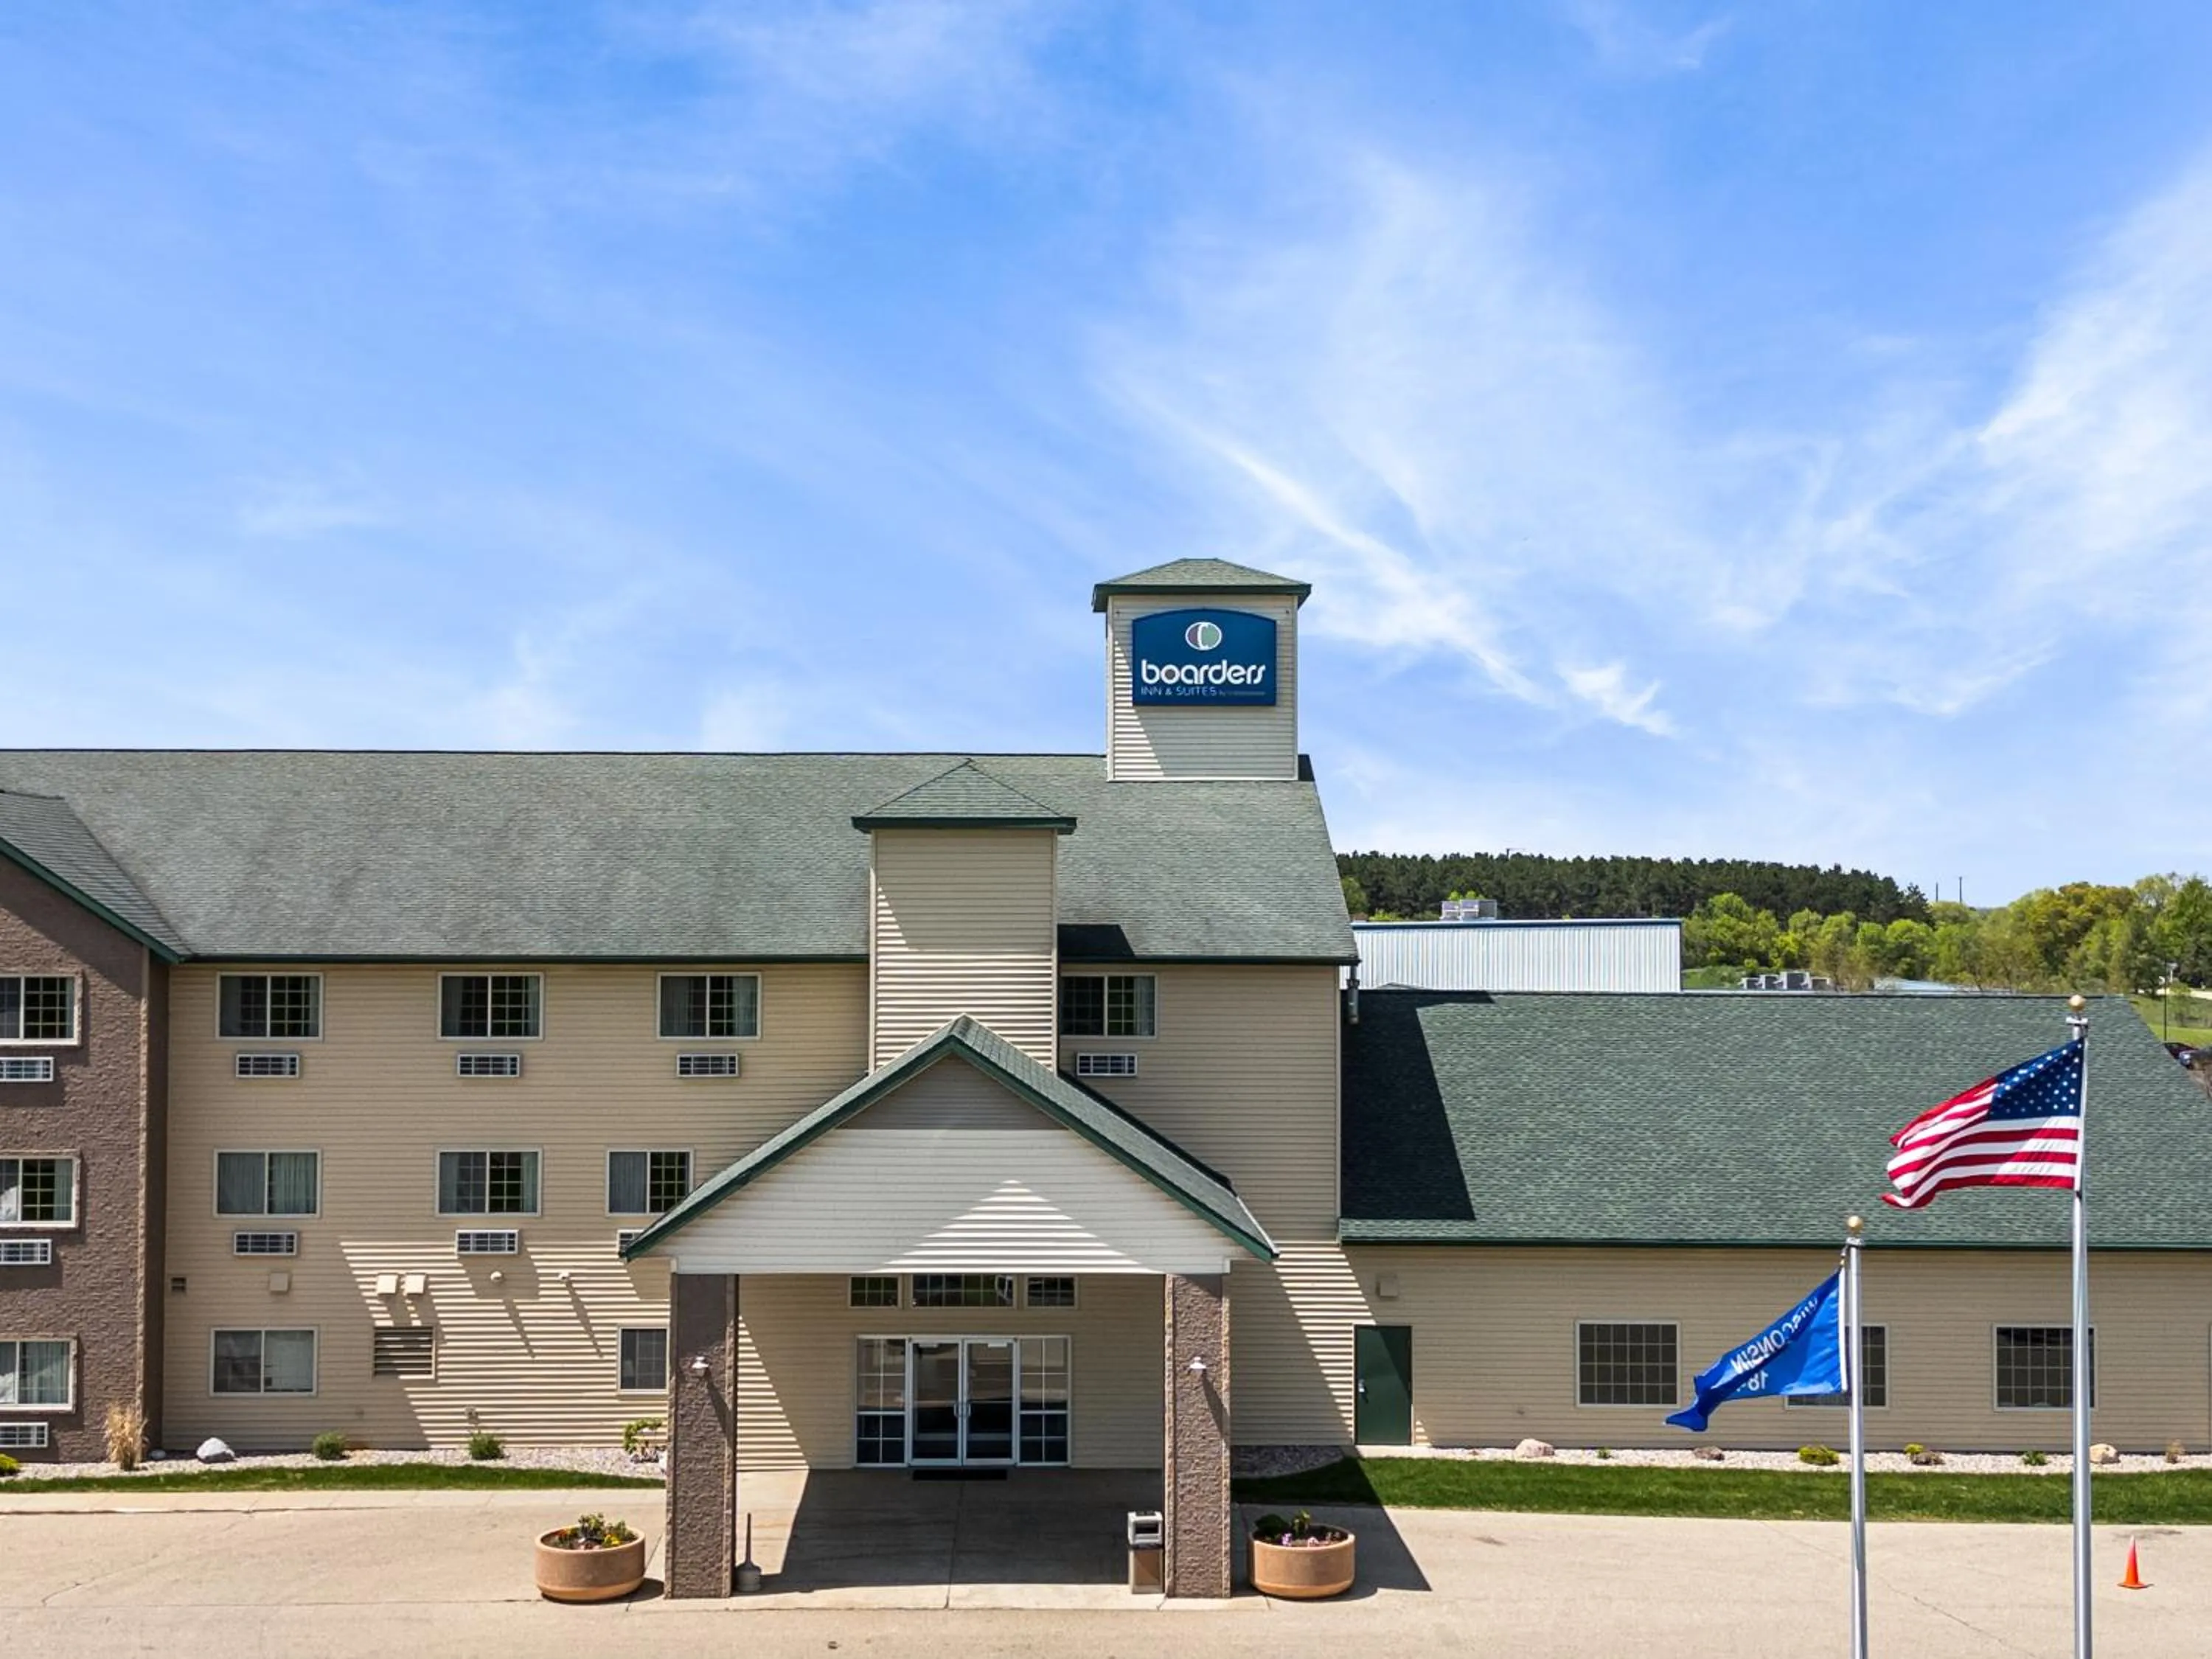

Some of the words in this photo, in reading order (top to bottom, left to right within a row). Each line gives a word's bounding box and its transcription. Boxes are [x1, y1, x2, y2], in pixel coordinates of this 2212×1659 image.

[1141, 658, 1266, 685] boarders
[1141, 686, 1162, 696] INN
[1164, 687, 1173, 696] &
[1175, 686, 1217, 697] SUITES
